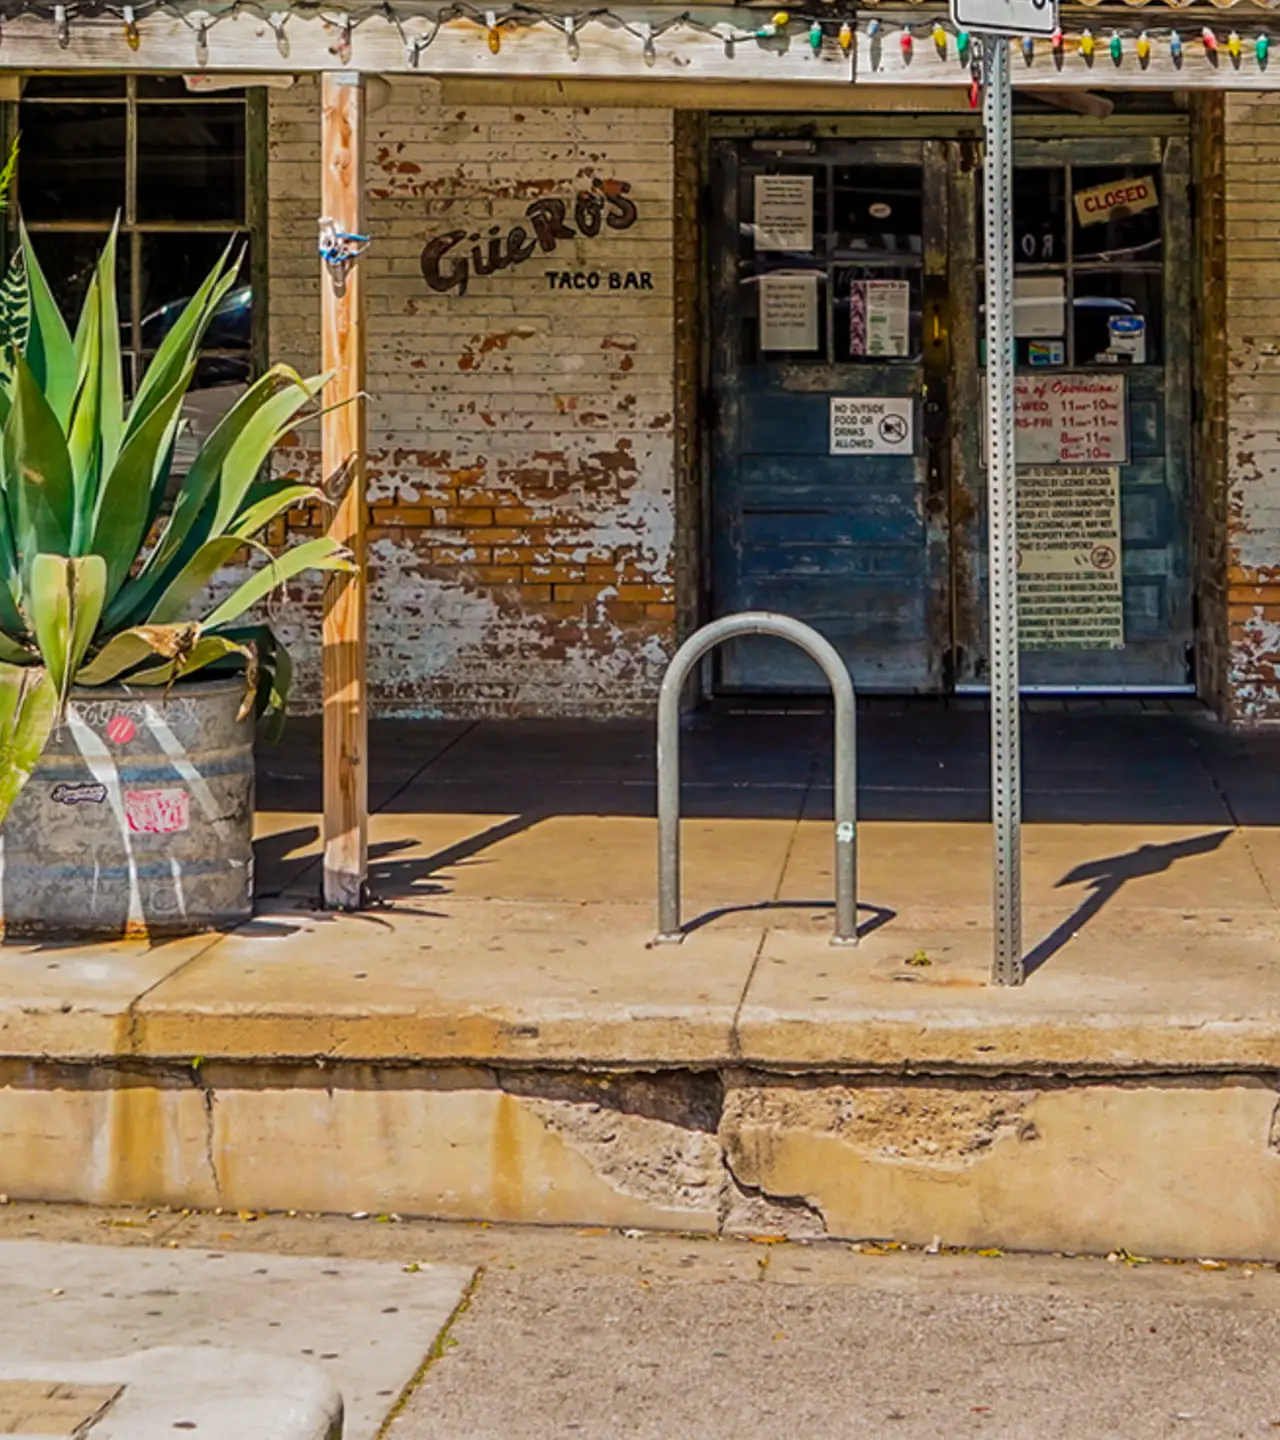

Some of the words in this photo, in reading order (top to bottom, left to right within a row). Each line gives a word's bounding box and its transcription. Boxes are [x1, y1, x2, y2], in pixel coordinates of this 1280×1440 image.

[1083, 184, 1149, 213] CLOSED
[545, 271, 599, 290] TACO
[608, 271, 653, 290] BAR
[834, 404, 848, 413] NO
[850, 403, 885, 414] OUTSIDE
[834, 415, 858, 425] FOOD
[860, 415, 874, 425] OR
[834, 427, 866, 436] DRINKS
[835, 439, 874, 448] ALLOWED
